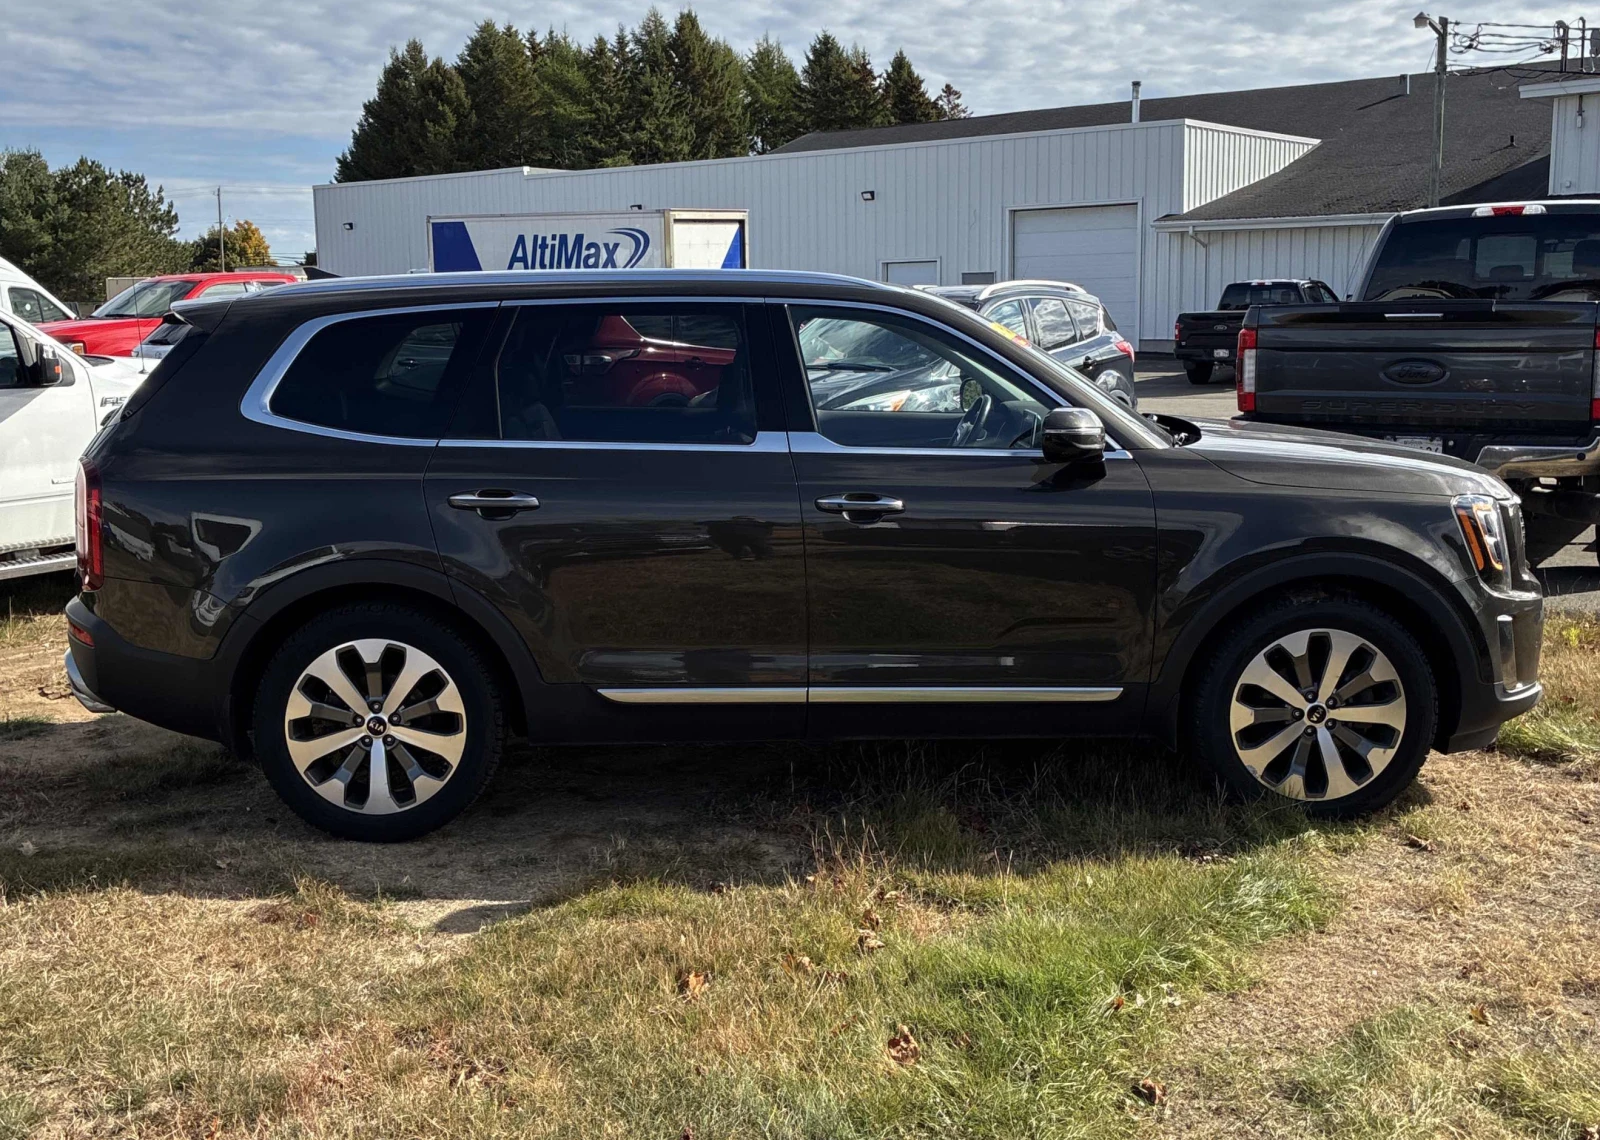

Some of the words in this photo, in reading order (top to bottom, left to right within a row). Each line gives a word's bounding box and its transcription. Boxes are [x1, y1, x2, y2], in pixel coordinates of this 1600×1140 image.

[507, 233, 620, 270] AltiMax
[1301, 400, 1424, 413] SUPER
[1433, 400, 1537, 415] DUTY
[369, 720, 385, 732] KIA
